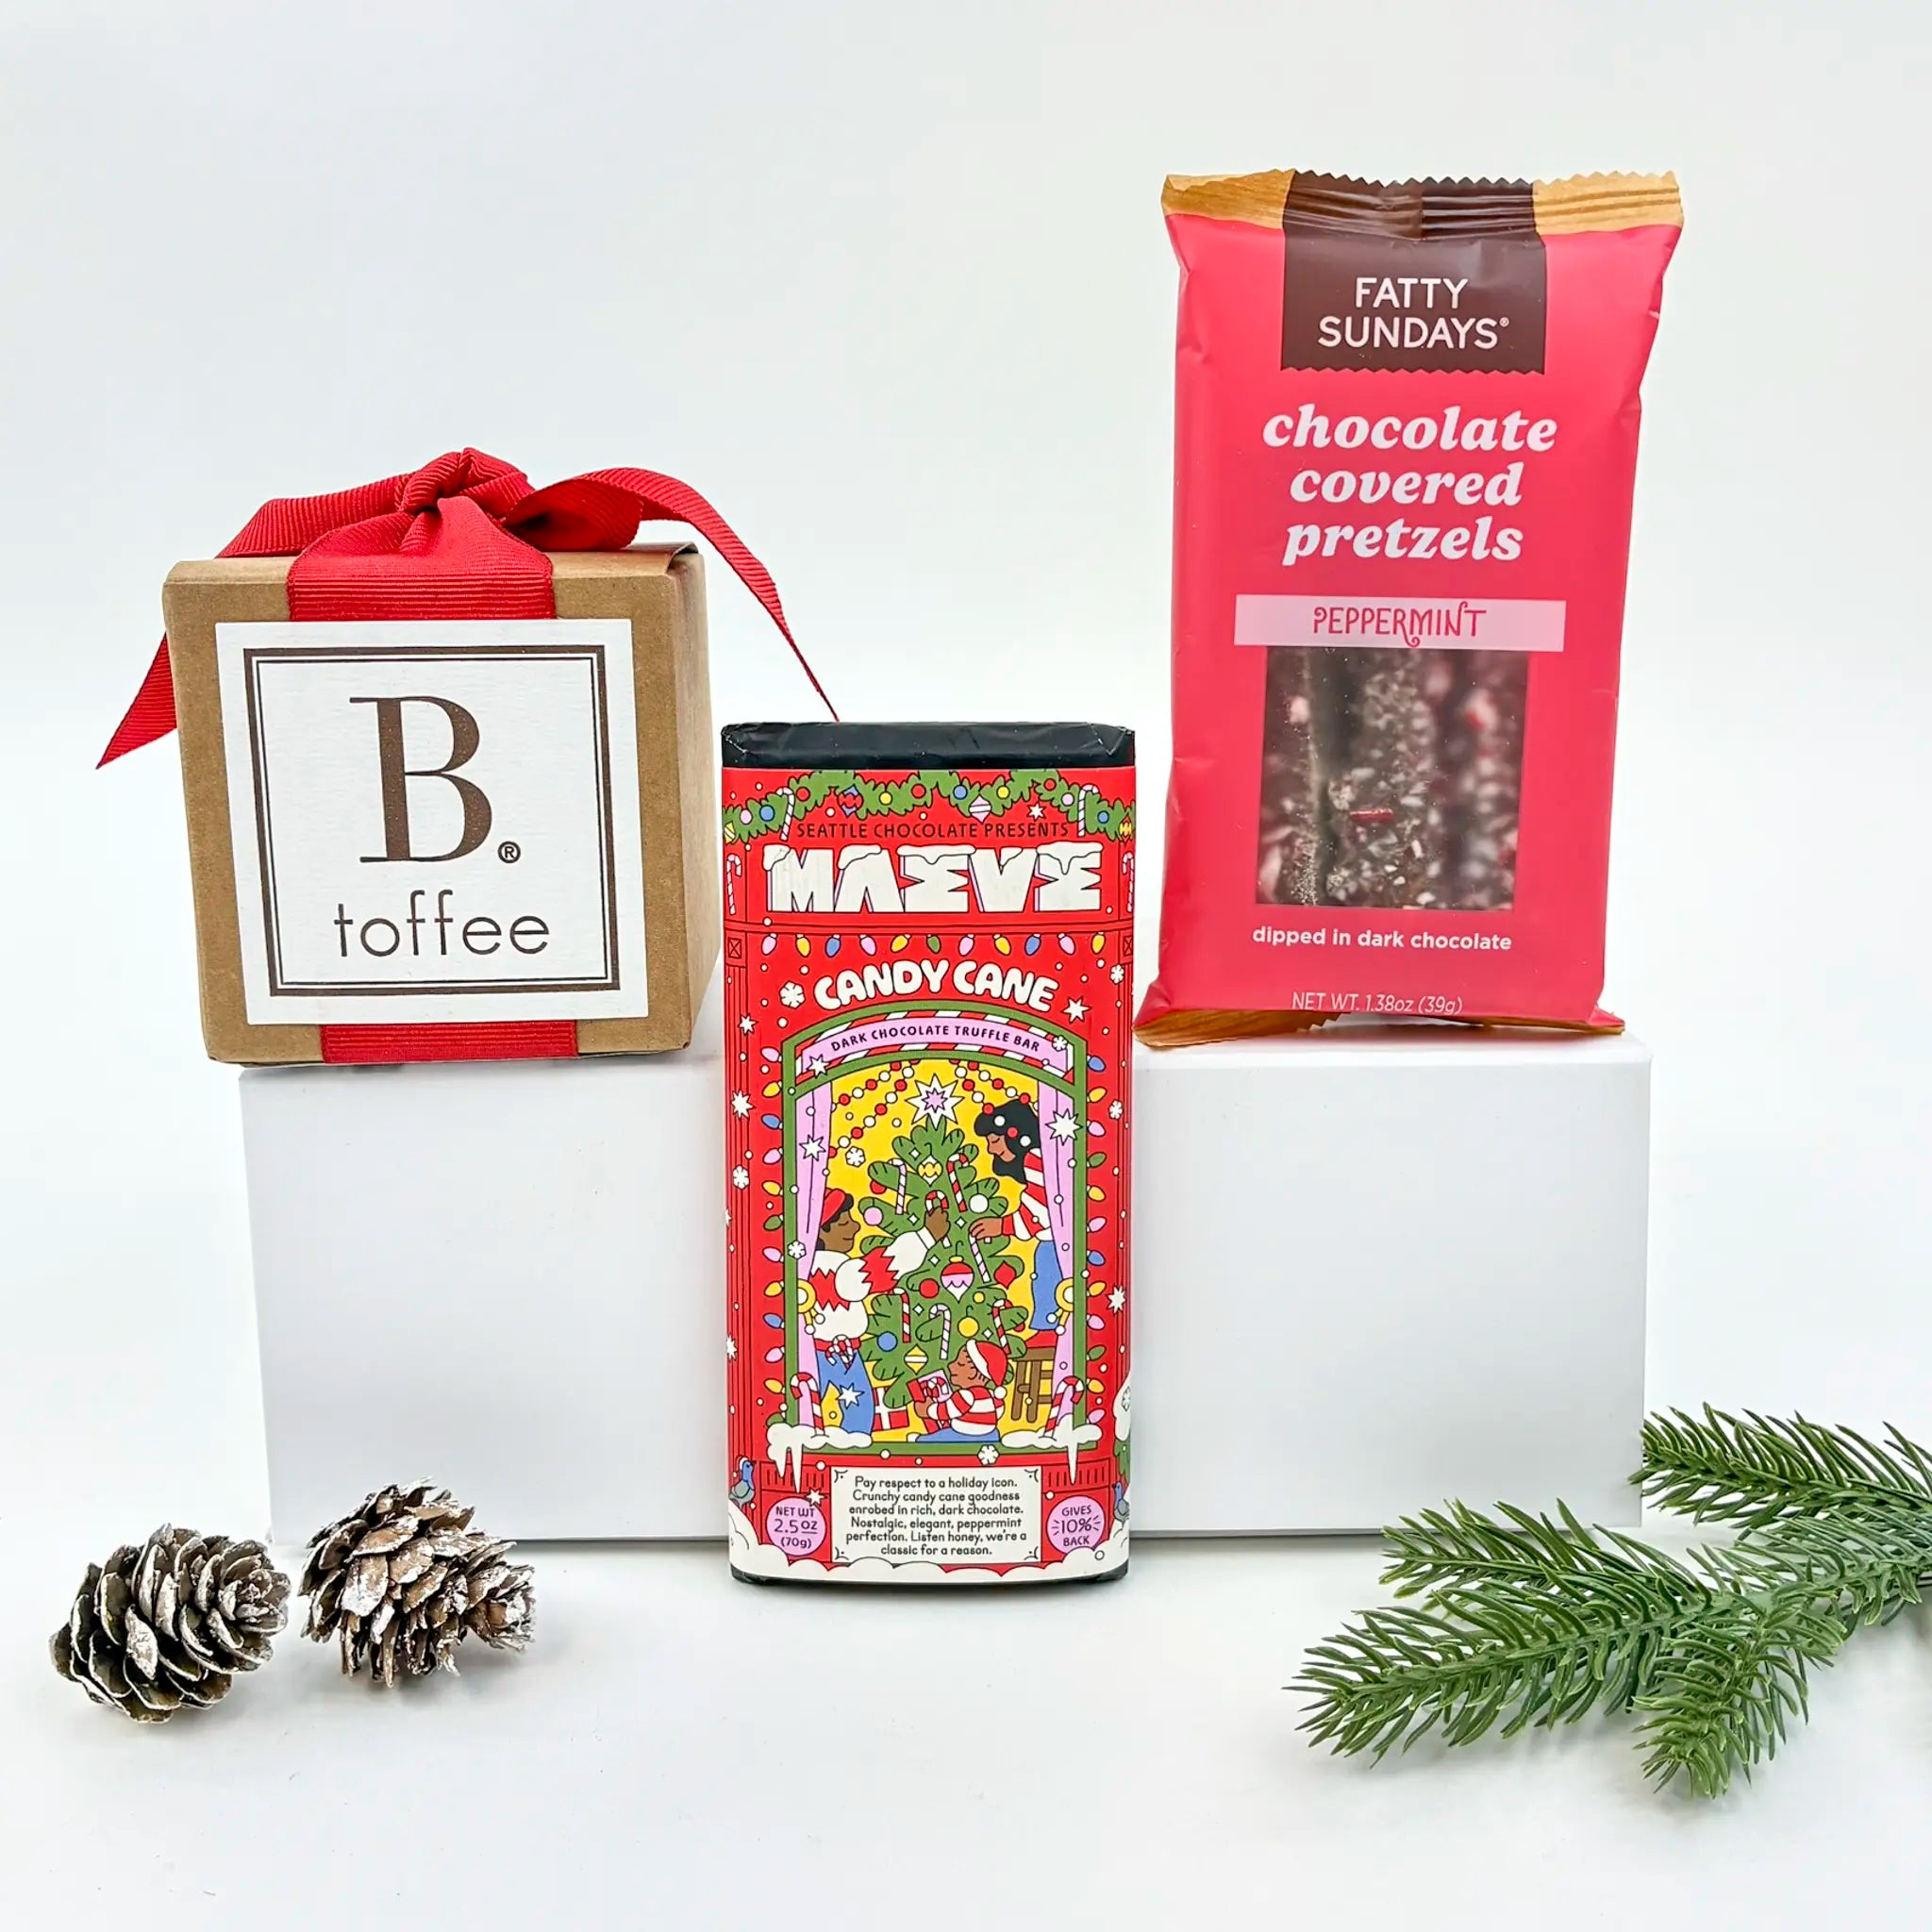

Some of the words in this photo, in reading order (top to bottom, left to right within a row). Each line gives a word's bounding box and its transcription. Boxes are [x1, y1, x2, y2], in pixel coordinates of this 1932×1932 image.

[1355, 277, 1468, 308] FATTY
[1263, 404, 1557, 452] chocolate
[1290, 463, 1524, 506] covered
[1282, 517, 1524, 566] pretzels
[1313, 601, 1487, 647] PEPPERMINT
[797, 822, 867, 838] SEATTLE
[874, 822, 977, 838] CHOCOLATE
[984, 822, 1069, 838] PRESENTS
[763, 842, 1103, 913] MAEVE
[334, 890, 549, 958] toffee
[1253, 925, 1325, 946] dipped
[1333, 928, 1351, 945] in
[1357, 929, 1405, 948] dark
[1410, 931, 1512, 950] chocolate
[814, 959, 949, 1010] CANDY
[953, 960, 1058, 1012] CANE
[1291, 991, 1326, 1010] NET
[1331, 993, 1360, 1011] WT.
[1365, 993, 1414, 1013] 1.38oz
[1418, 995, 1463, 1015] (39g)
[831, 1032, 867, 1052] DARK
[871, 1024, 950, 1040] CHOCOLATE
[955, 1024, 1009, 1042] TRUFFLE
[1013, 1036, 1040, 1052] BAR
[855, 1475, 876, 1491] Pay
[879, 1478, 922, 1491] respect
[924, 1478, 937, 1488] to
[938, 1480, 946, 1489] a
[948, 1476, 989, 1491] holiday
[991, 1477, 1018, 1488] icon.
[852, 1489, 900, 1506] Crunchy
[902, 1490, 937, 1506] candy
[938, 1493, 966, 1502] cane
[967, 1490, 1021, 1507] goodness
[775, 1506, 795, 1517] NET
[797, 1507, 815, 1518] WT
[849, 1503, 895, 1515] enrobed
[897, 1505, 908, 1515] in
[910, 1504, 937, 1516] rich,
[938, 1503, 964, 1515] dark
[966, 1503, 1024, 1515] chocolate.
[1061, 1505, 1092, 1517] GIVES
[774, 1518, 799, 1534] 2.5
[851, 1516, 908, 1533] Nostalgic,
[909, 1517, 955, 1533] elegant,
[957, 1517, 1023, 1533] peppermint
[1061, 1516, 1092, 1534] 10%
[780, 1536, 812, 1549] (70g)
[845, 1529, 908, 1545] perfection.
[910, 1530, 945, 1542] Listen
[947, 1530, 984, 1546] honey,
[985, 1528, 1018, 1541] we're
[1019, 1532, 1027, 1541] a
[1062, 1535, 1091, 1547] BACK
[880, 1543, 919, 1556] classic
[921, 1543, 939, 1556] for
[941, 1546, 948, 1556] a
[950, 1546, 993, 1556] reason.
